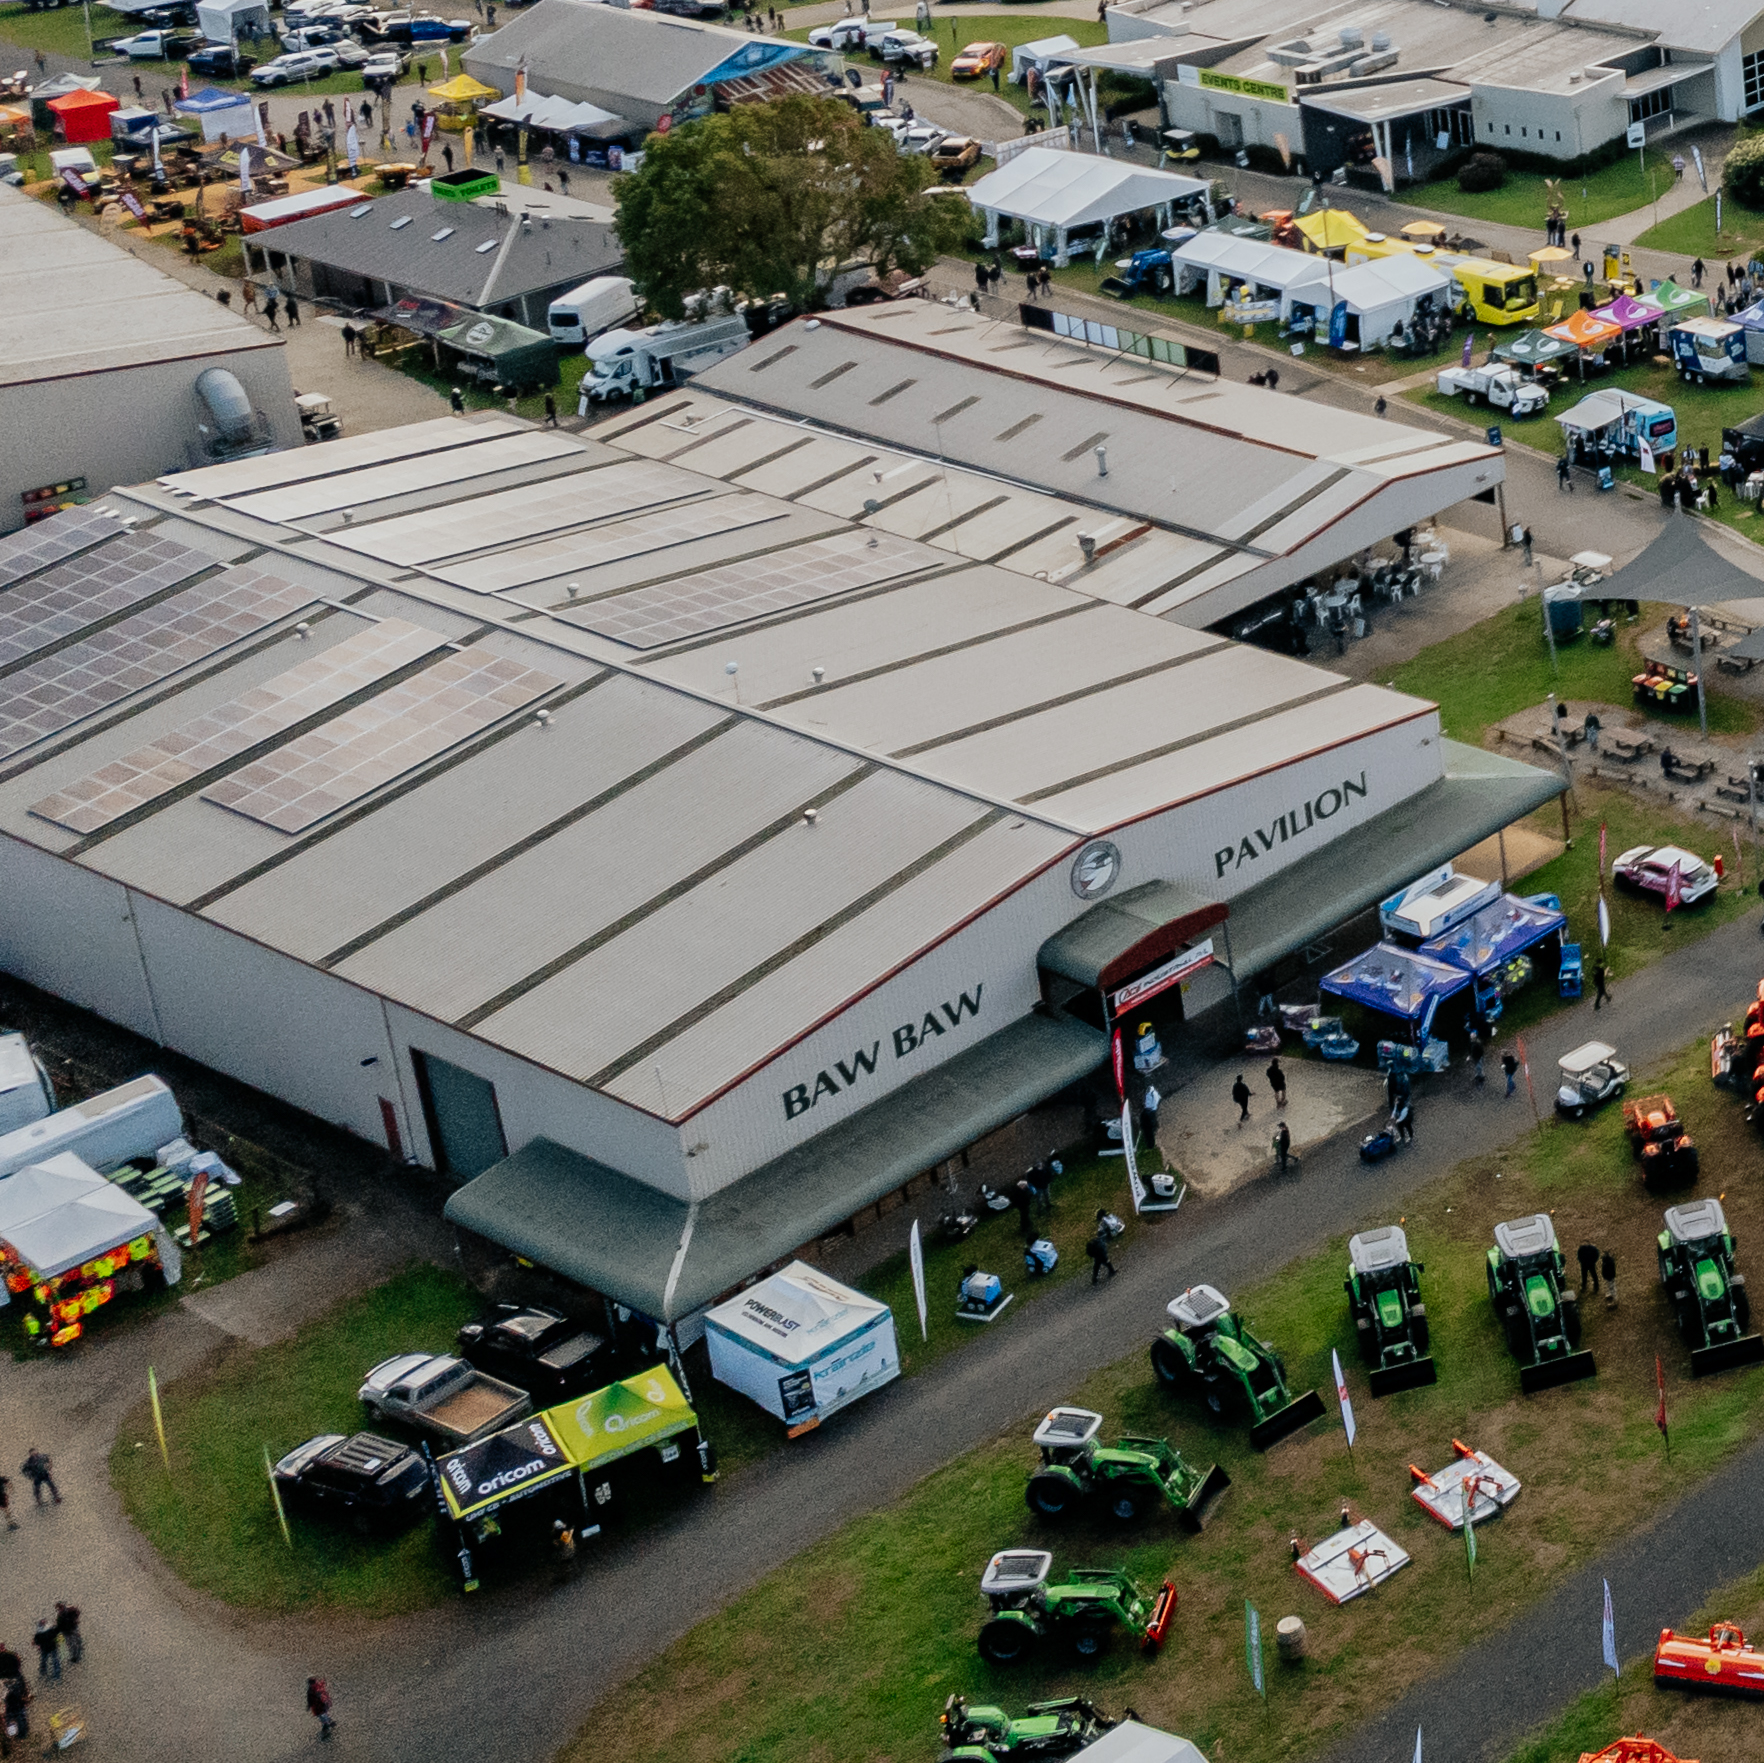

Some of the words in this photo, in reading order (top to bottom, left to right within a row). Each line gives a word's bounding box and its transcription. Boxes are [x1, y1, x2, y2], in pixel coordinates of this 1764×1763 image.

[1201, 73, 1240, 91] EVENTS
[1242, 81, 1286, 100] CENTRE
[1214, 771, 1369, 879] PAVILION
[782, 1040, 880, 1122] BAW
[892, 983, 984, 1060] BAW
[744, 1299, 802, 1332] POWERBLAST
[477, 1458, 545, 1496] oricom
